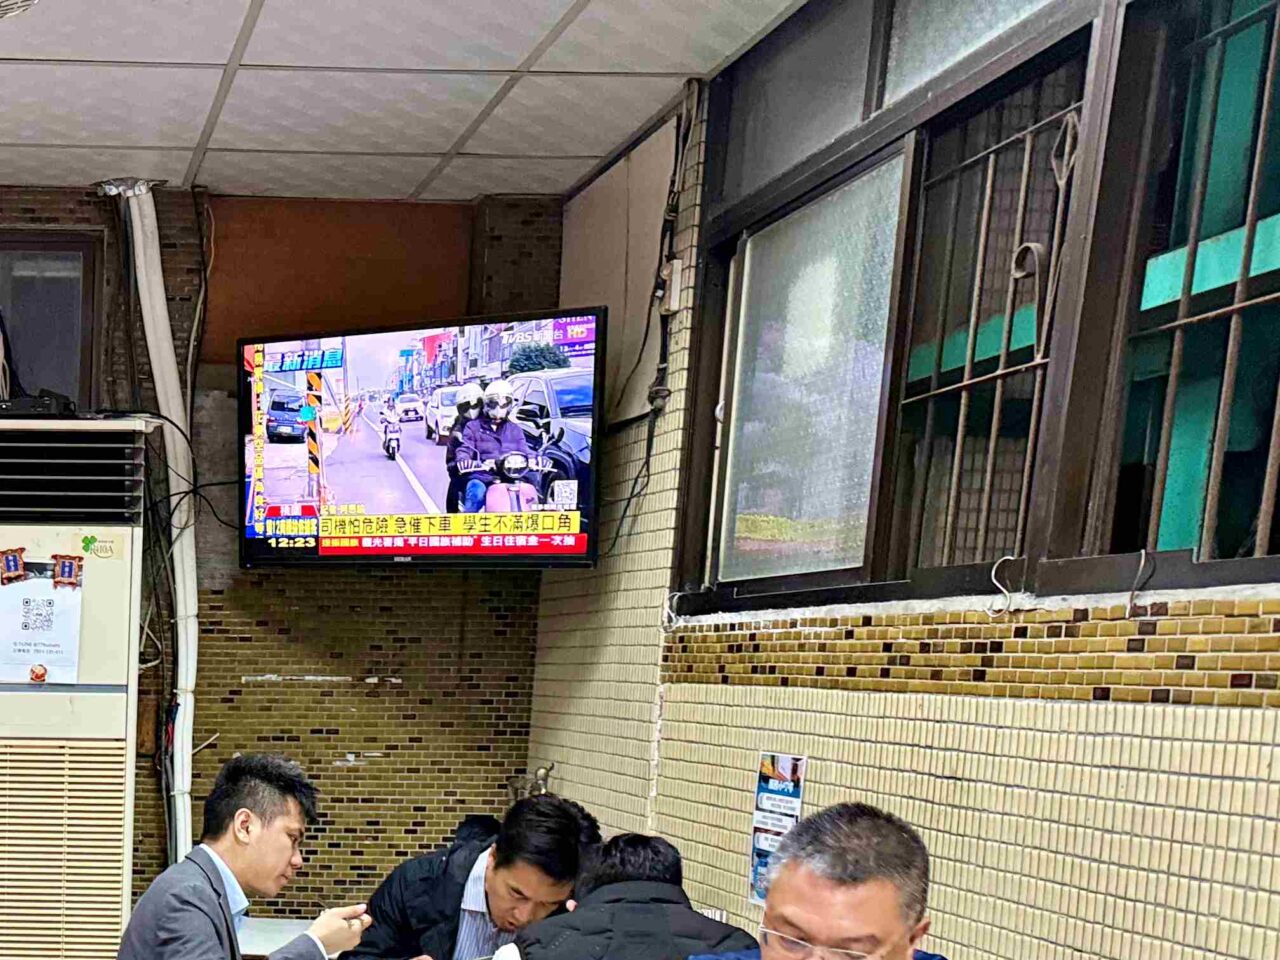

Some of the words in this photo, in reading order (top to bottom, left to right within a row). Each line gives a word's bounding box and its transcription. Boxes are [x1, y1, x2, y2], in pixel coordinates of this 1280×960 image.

[500, 331, 533, 344] TVBS
[263, 348, 342, 372] 最新消息
[463, 513, 572, 533] 學生不滿爆口角
[268, 537, 316, 547] 12:23
